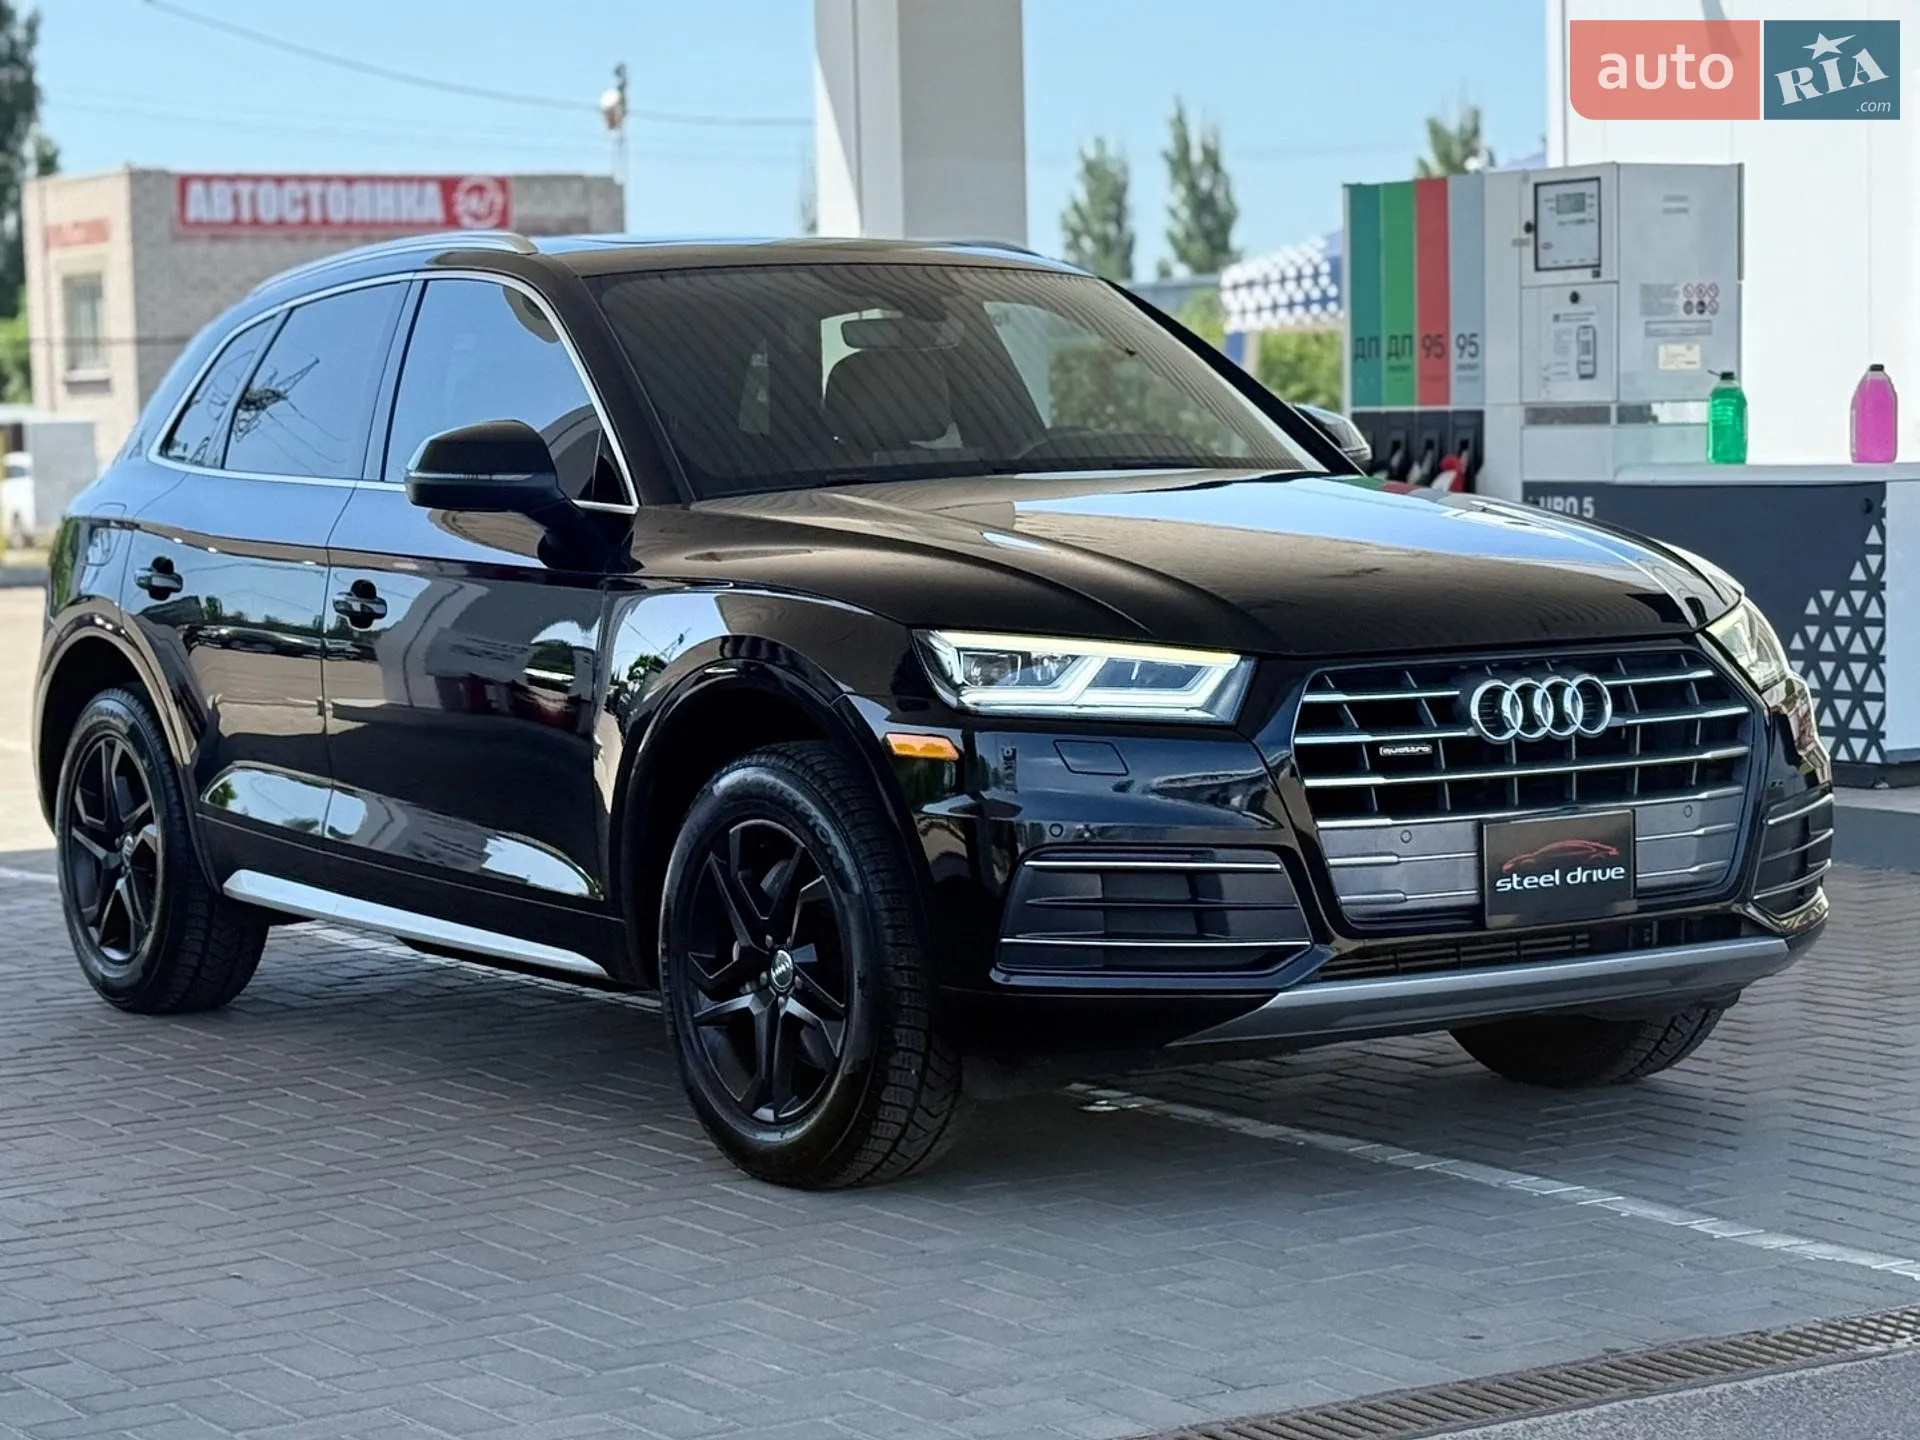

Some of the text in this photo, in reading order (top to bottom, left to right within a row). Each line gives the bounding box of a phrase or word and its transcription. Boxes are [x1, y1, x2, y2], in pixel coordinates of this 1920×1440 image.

[186, 179, 445, 223] АВТОСТОЯНКА
[1353, 335, 1380, 362] ДП
[1386, 333, 1413, 361] ДП
[1421, 333, 1445, 359] 95
[1455, 332, 1480, 359] 95
[1527, 495, 1595, 519] URO 5
[1495, 866, 1625, 892] steel drive
